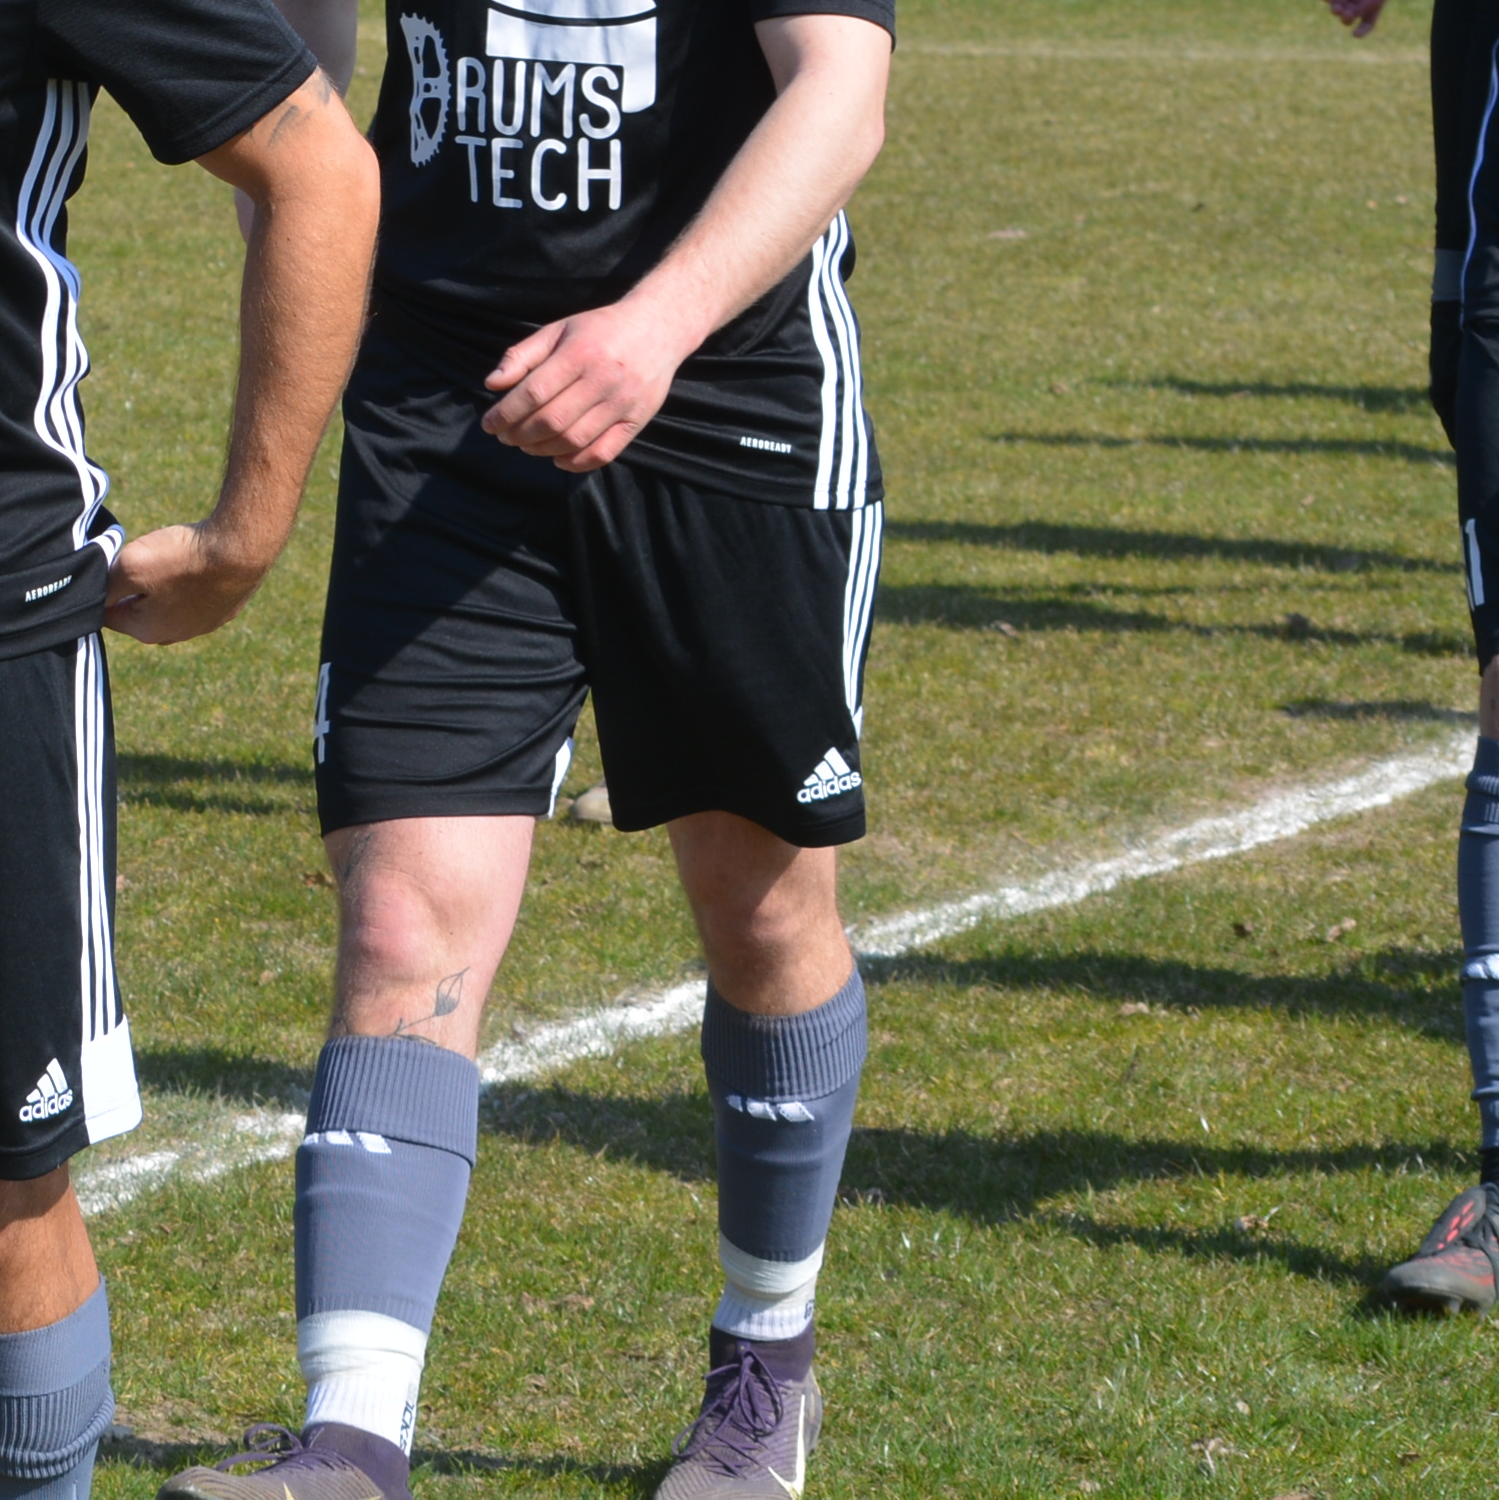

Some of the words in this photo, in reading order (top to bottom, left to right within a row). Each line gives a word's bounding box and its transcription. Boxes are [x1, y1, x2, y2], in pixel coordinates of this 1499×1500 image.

[455, 135, 622, 212] TECH
[739, 435, 793, 454] AEROREADY
[796, 771, 863, 804] adidas
[18, 1088, 74, 1123] adidas
